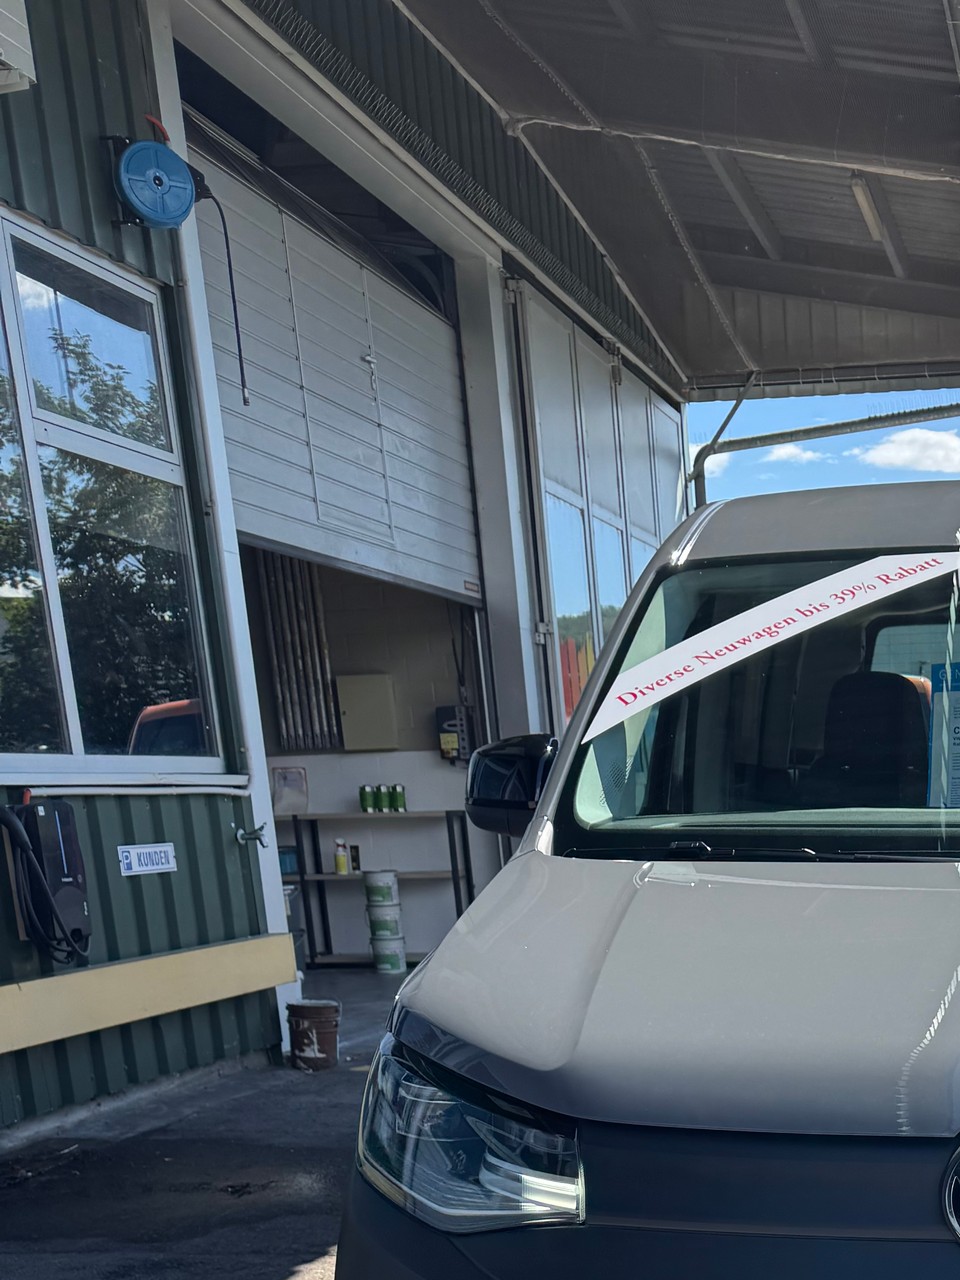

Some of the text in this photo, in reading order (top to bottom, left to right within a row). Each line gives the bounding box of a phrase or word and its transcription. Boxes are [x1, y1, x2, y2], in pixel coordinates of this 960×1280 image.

[615, 555, 944, 708] Diverse Neuwagen bis 39% Rabatt
[136, 850, 170, 868] KUNDEN
